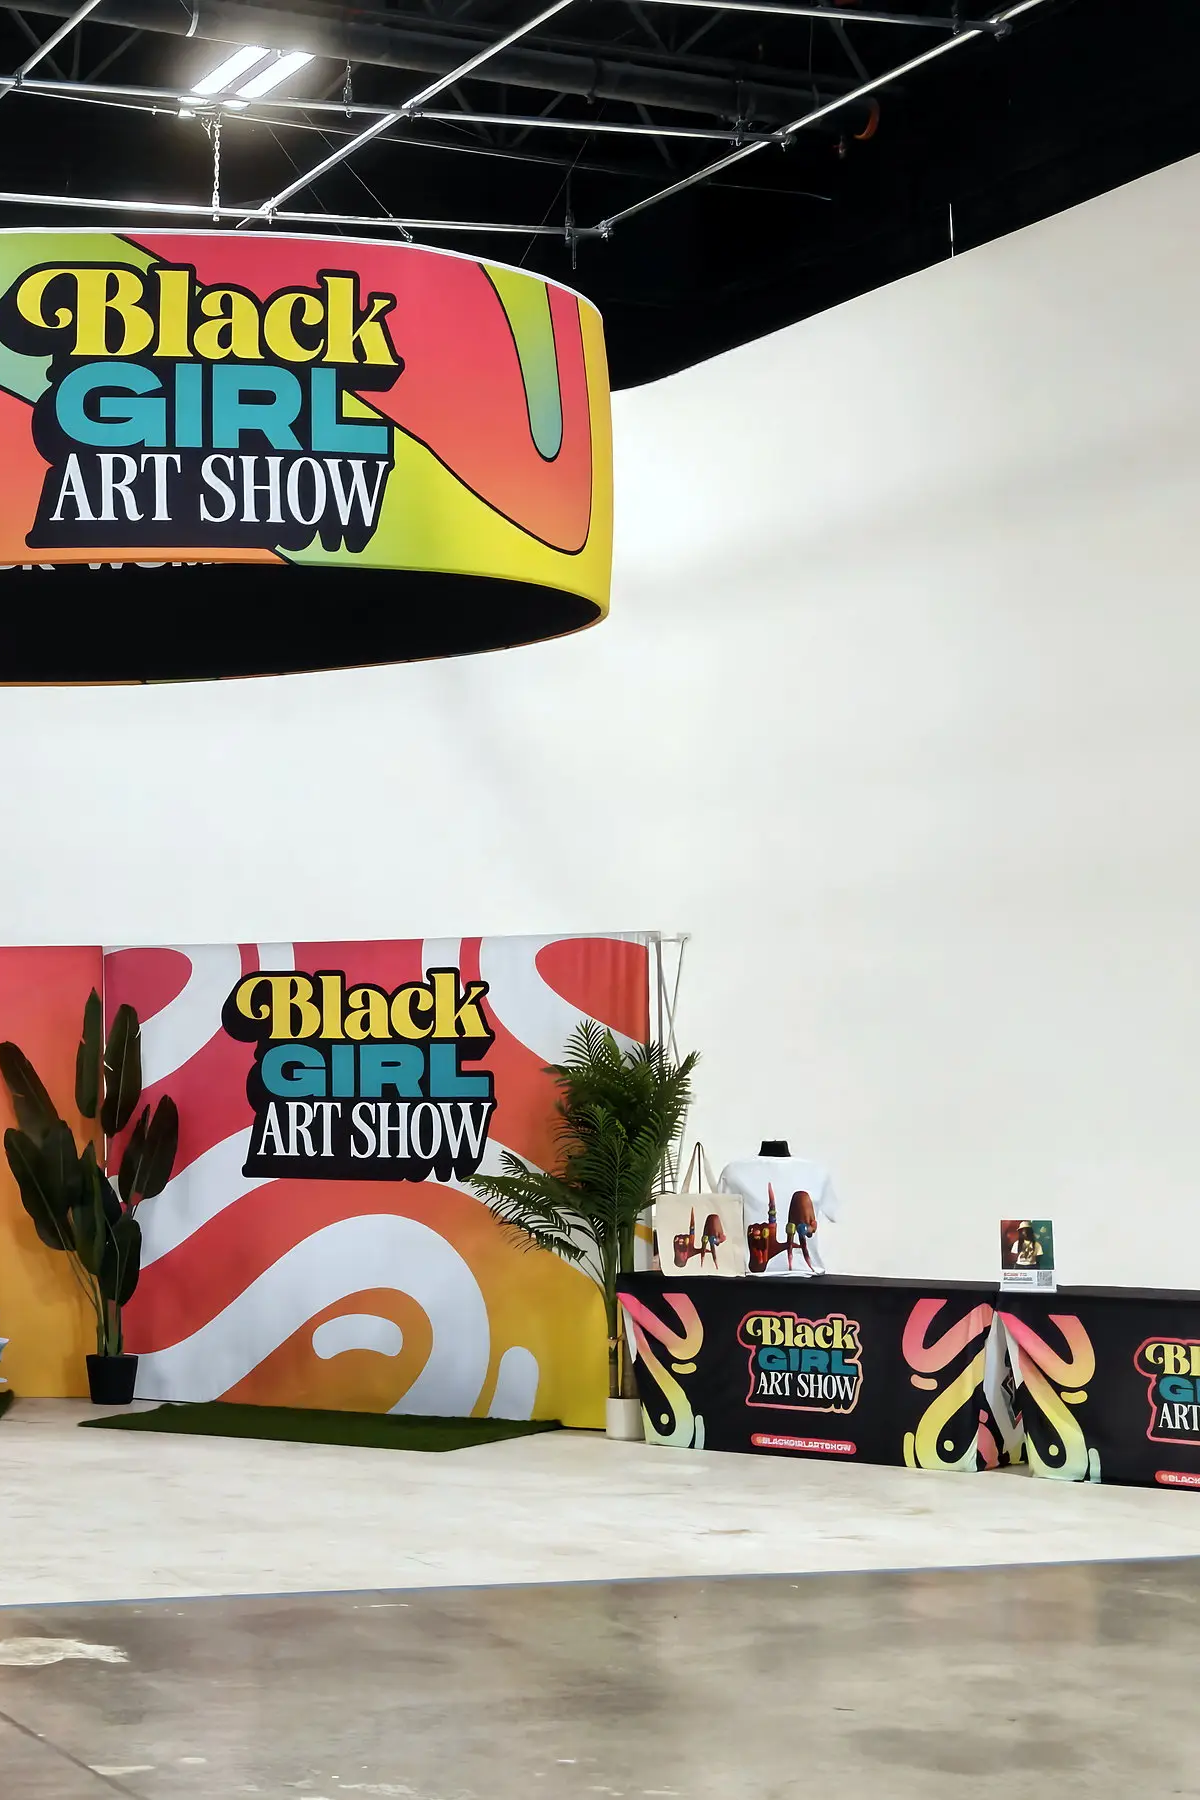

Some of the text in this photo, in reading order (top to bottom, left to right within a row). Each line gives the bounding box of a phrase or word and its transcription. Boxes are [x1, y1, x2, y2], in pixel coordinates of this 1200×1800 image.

[16, 268, 399, 366] Black
[55, 361, 388, 455] GIRL
[49, 453, 389, 527] ART SHOW
[235, 973, 491, 1040] Black
[261, 1043, 490, 1098] GIRL
[256, 1102, 492, 1159] ART SHOW
[745, 1316, 856, 1349] Black
[756, 1371, 858, 1401] ART SHOW
[757, 1347, 858, 1376] GIRL
